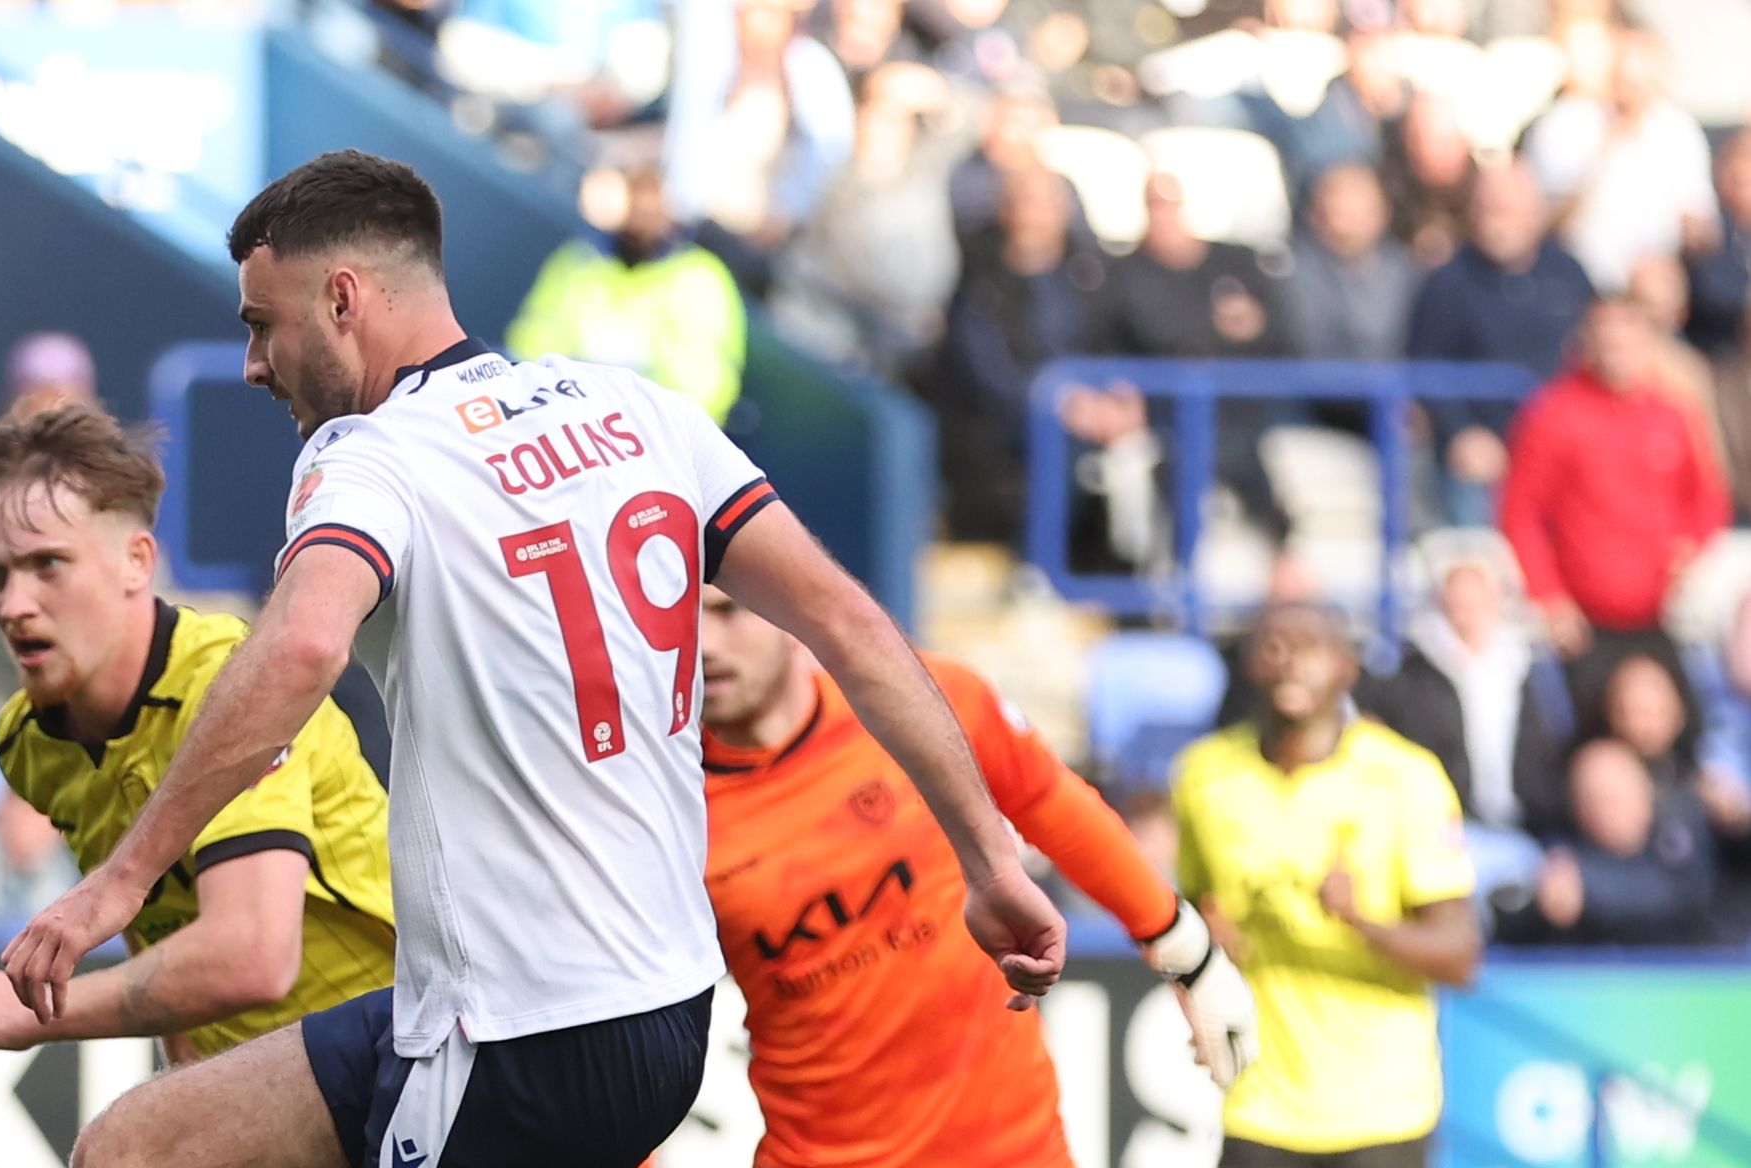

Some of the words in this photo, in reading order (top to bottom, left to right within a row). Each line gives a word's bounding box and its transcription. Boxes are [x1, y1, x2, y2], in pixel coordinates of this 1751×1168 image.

[485, 411, 644, 495] COLLNS
[498, 490, 698, 764] 19
[597, 742, 613, 753] EFL
